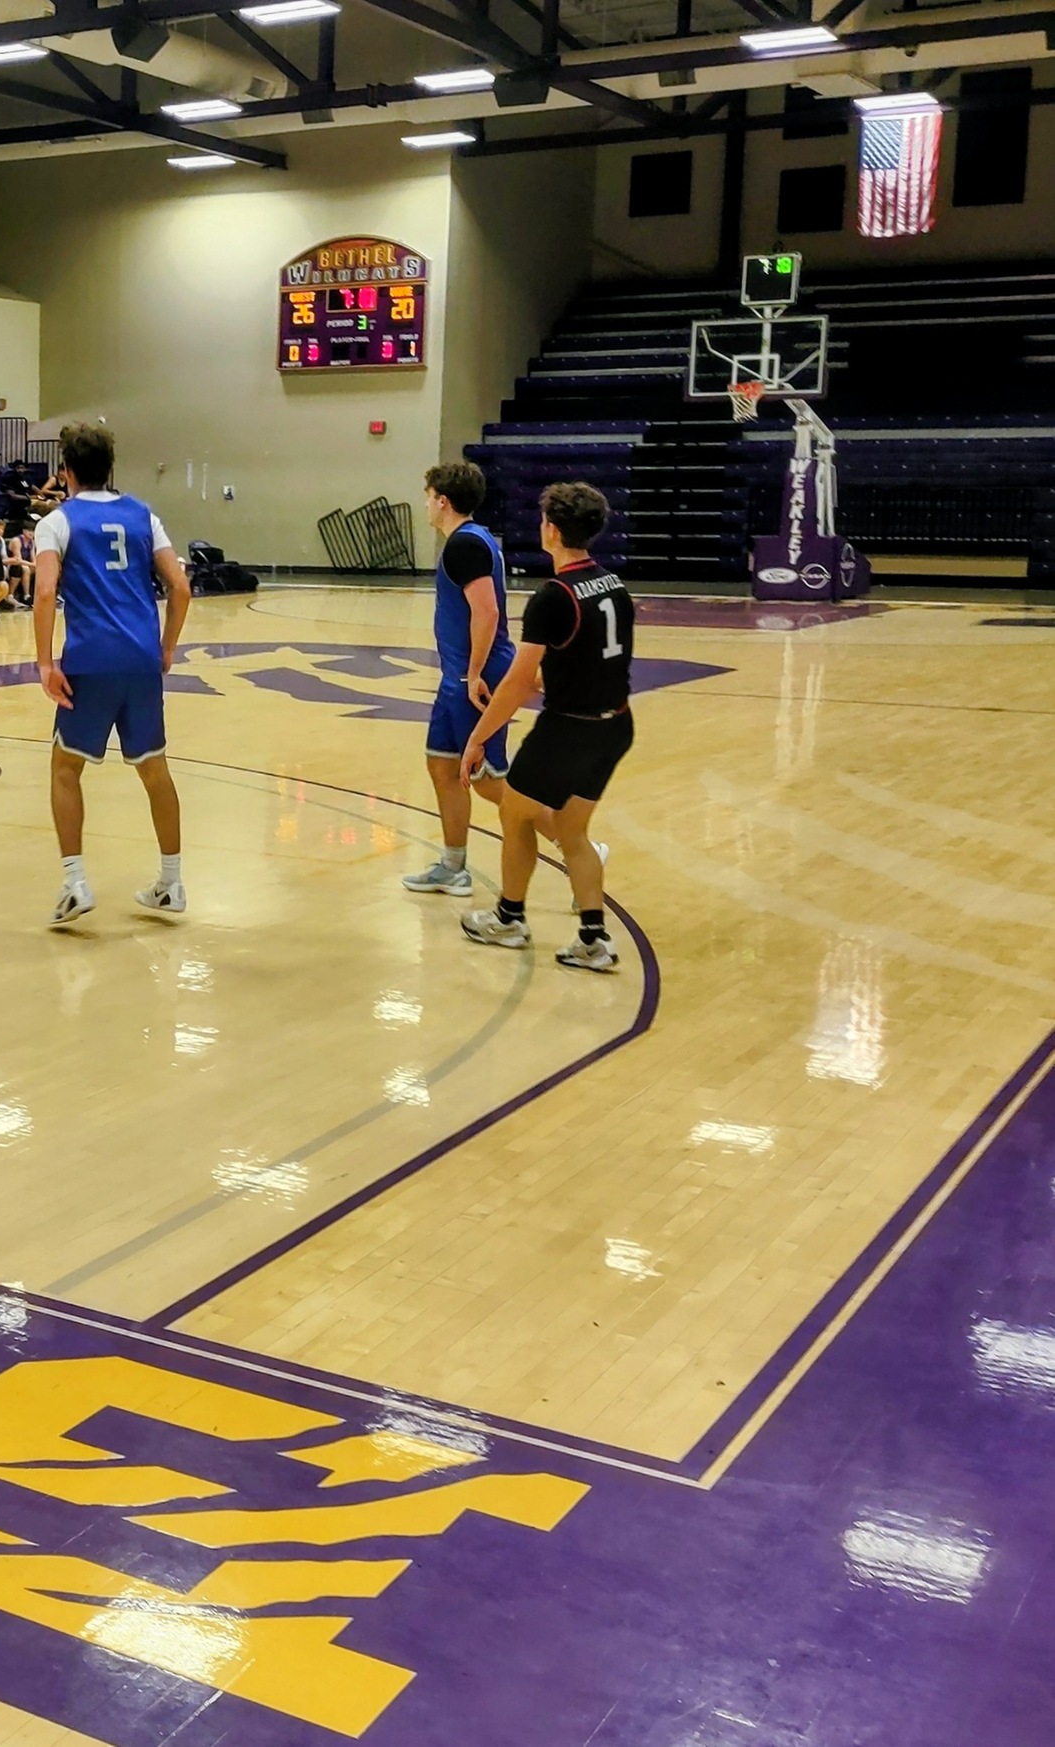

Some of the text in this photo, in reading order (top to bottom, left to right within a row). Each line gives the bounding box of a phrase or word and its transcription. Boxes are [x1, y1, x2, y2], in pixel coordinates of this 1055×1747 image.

[318, 244, 397, 268] BETHEL
[288, 256, 419, 284] WILDCATS
[293, 304, 315, 325] 26
[357, 314, 368, 330] 3
[391, 298, 415, 320] 20
[788, 458, 812, 565] WEAKLEY
[101, 523, 129, 571] 3
[597, 597, 623, 660] 1
